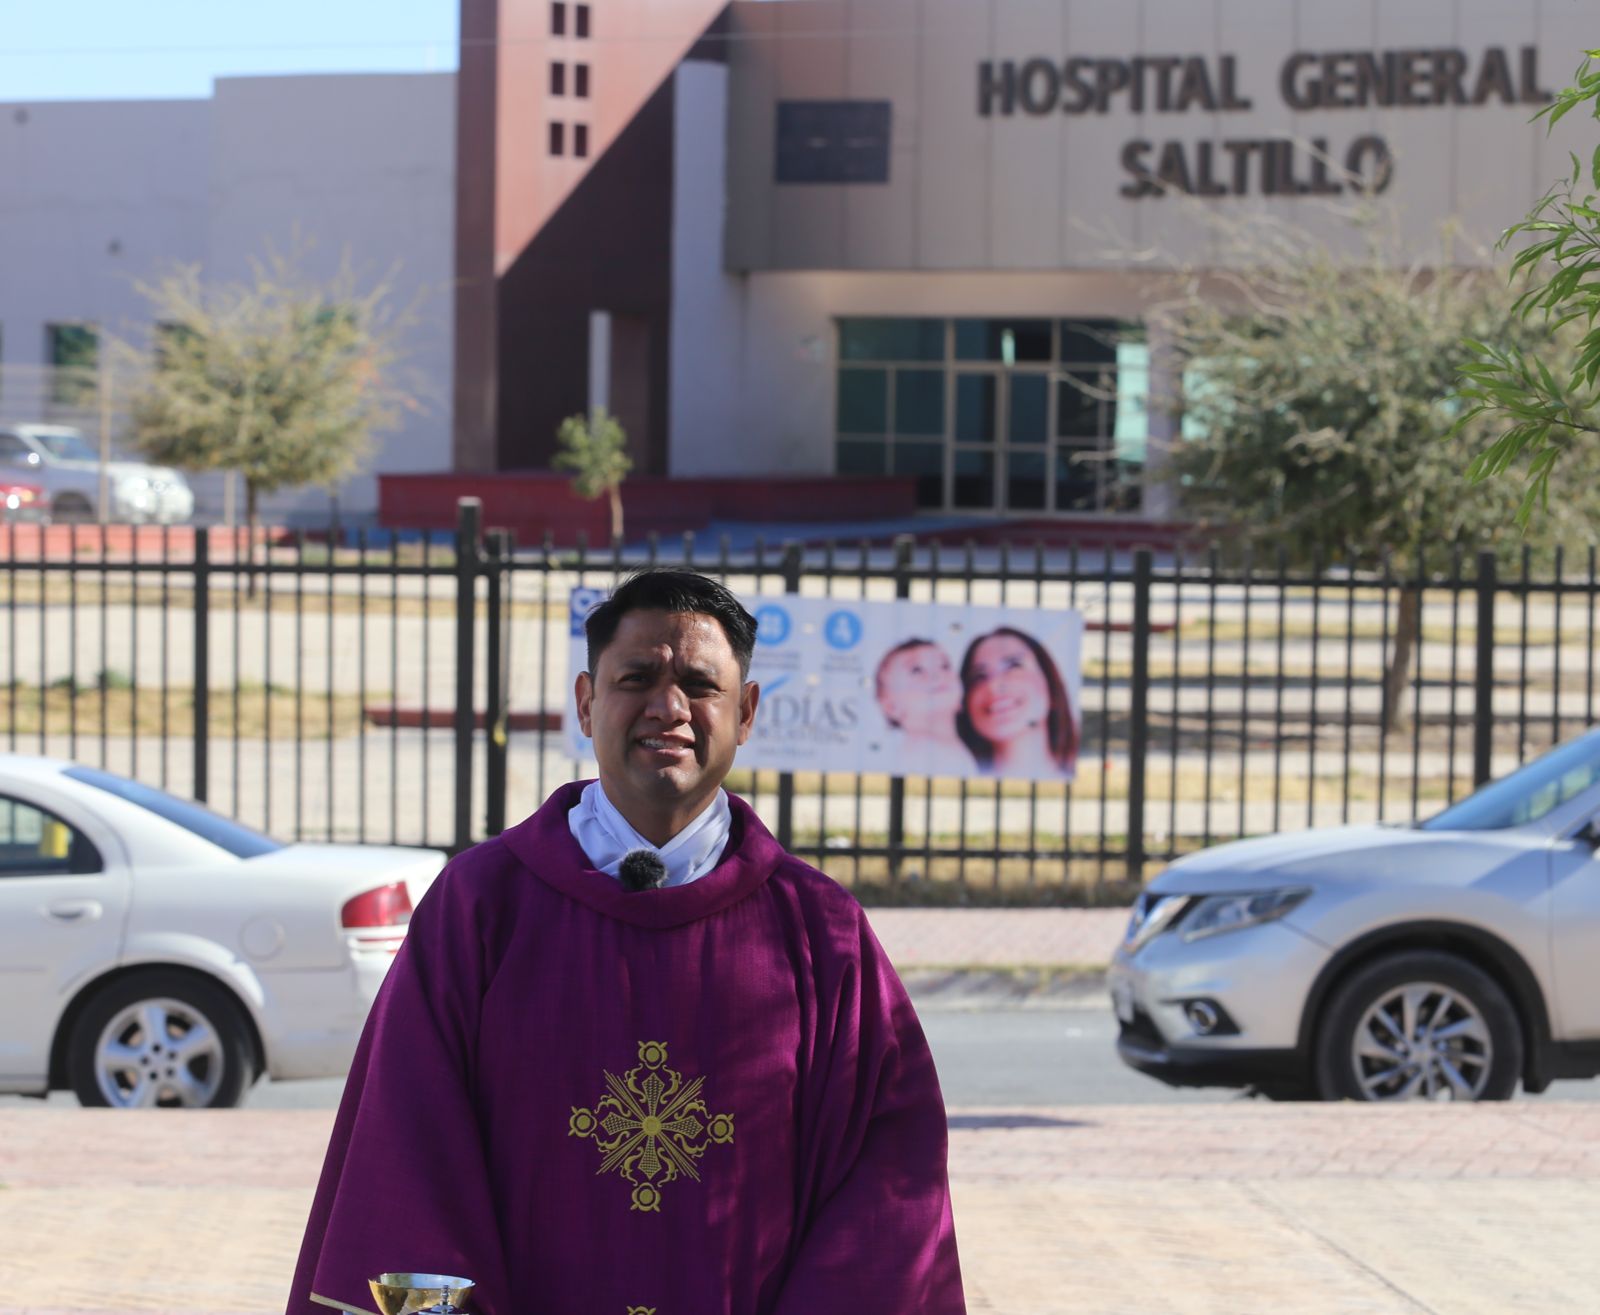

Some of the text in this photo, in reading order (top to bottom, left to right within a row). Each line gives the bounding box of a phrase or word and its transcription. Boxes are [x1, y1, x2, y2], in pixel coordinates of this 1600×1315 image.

[977, 46, 1554, 118] HOSPITAL GENERAL
[1119, 134, 1394, 199] SALTILLO
